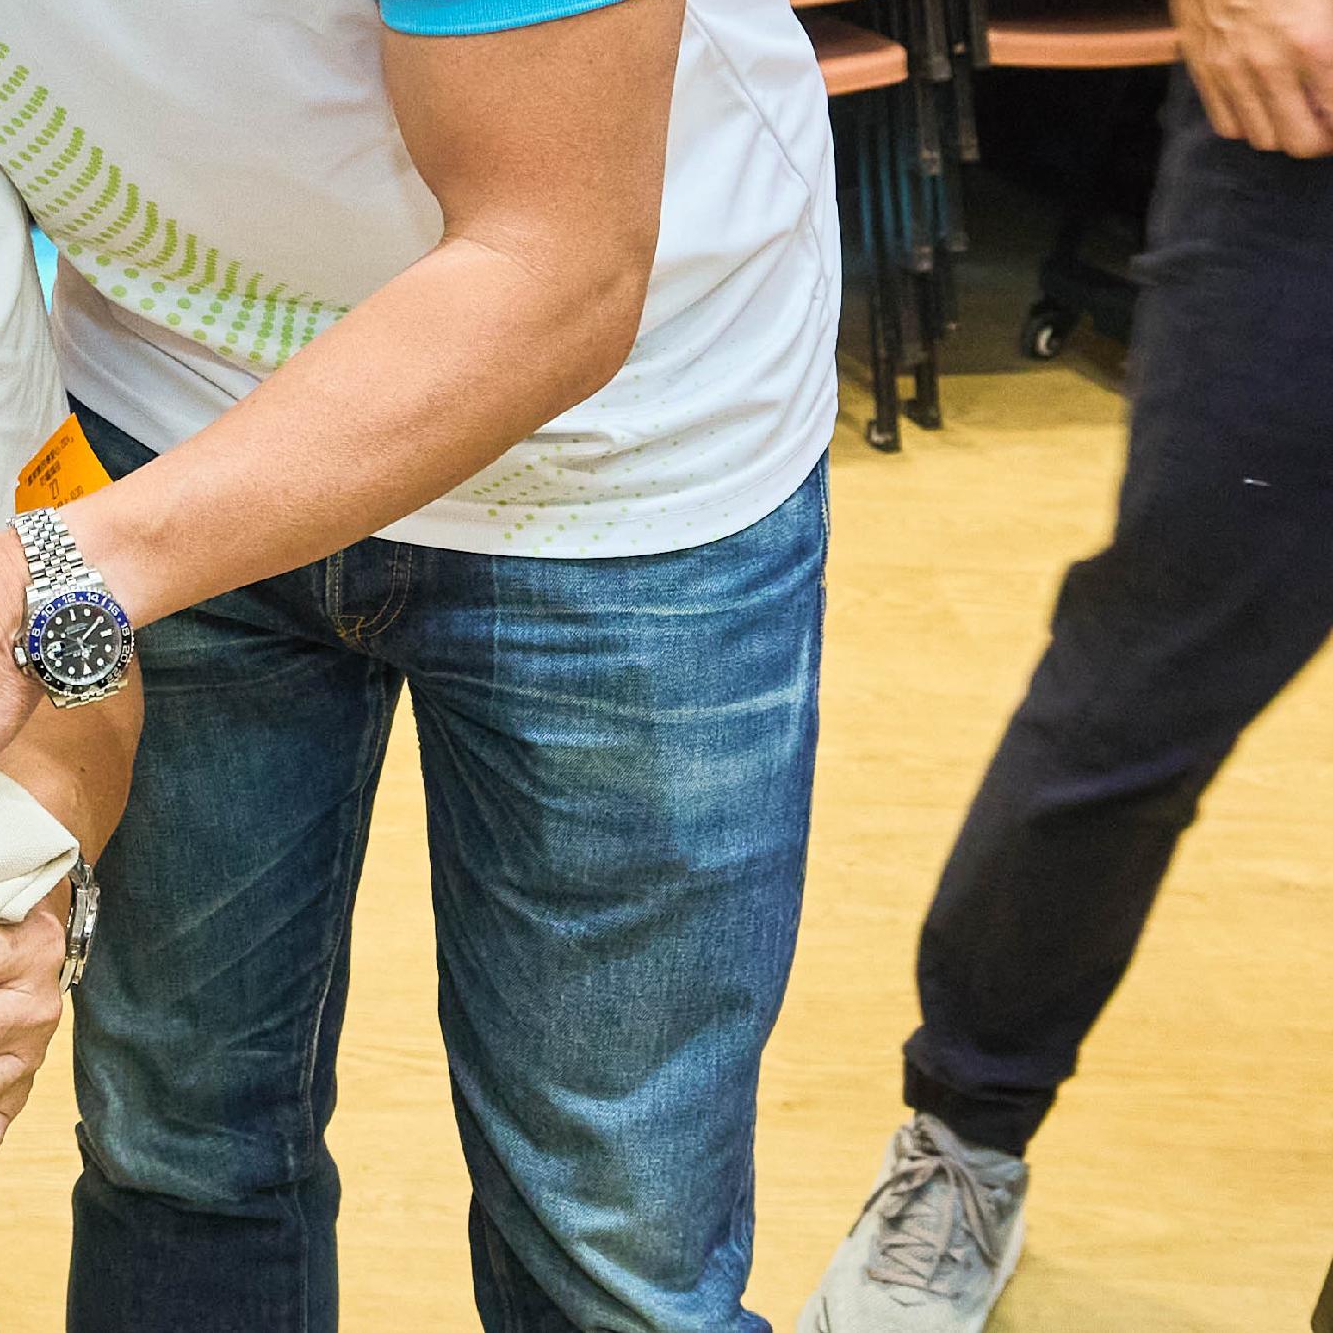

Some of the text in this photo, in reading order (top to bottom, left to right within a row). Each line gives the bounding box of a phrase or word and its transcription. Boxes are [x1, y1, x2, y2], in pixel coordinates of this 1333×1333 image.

[41, 604, 55, 617] 10
[62, 593, 76, 603] 12
[86, 592, 100, 603] 14
[120, 622, 130, 636] 18
